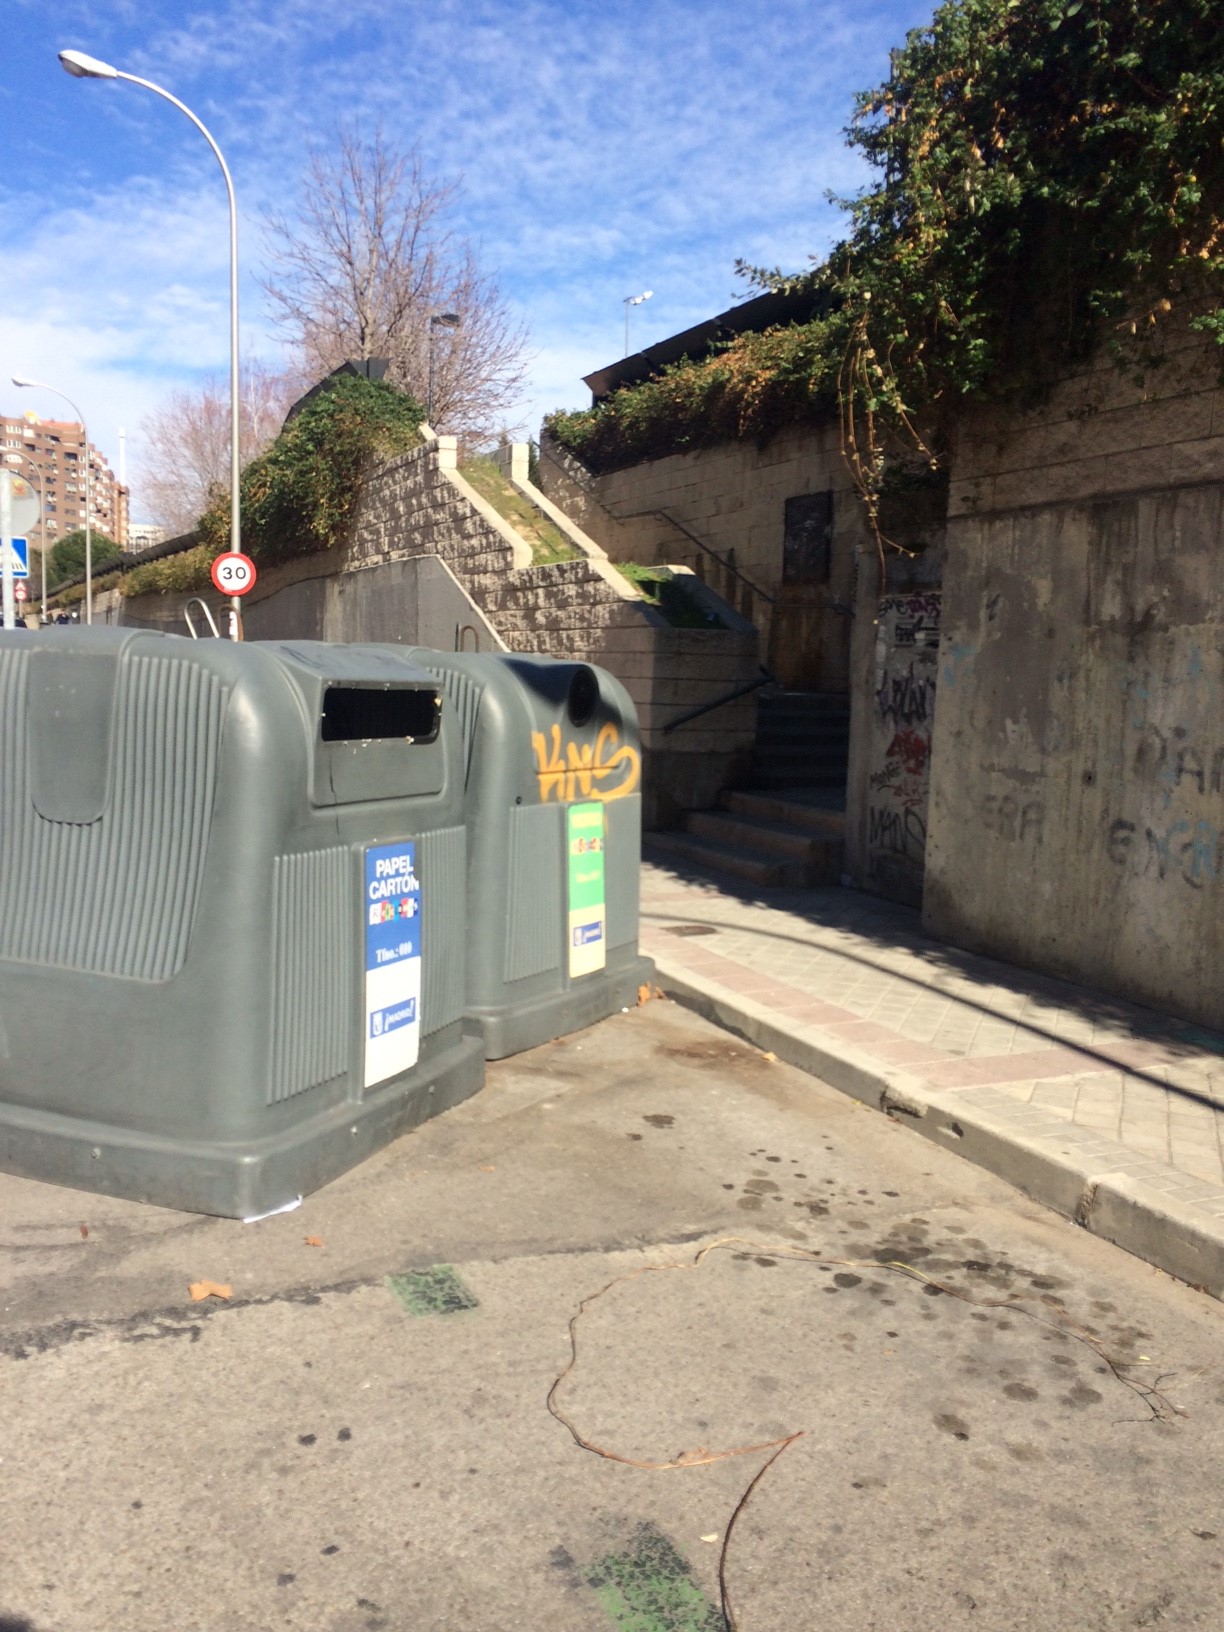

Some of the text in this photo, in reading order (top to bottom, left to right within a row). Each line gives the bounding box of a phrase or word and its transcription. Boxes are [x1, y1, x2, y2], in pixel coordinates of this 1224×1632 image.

[222, 566, 247, 580] 30
[375, 855, 414, 878] PAPEL
[369, 873, 421, 900] CARTÓN
